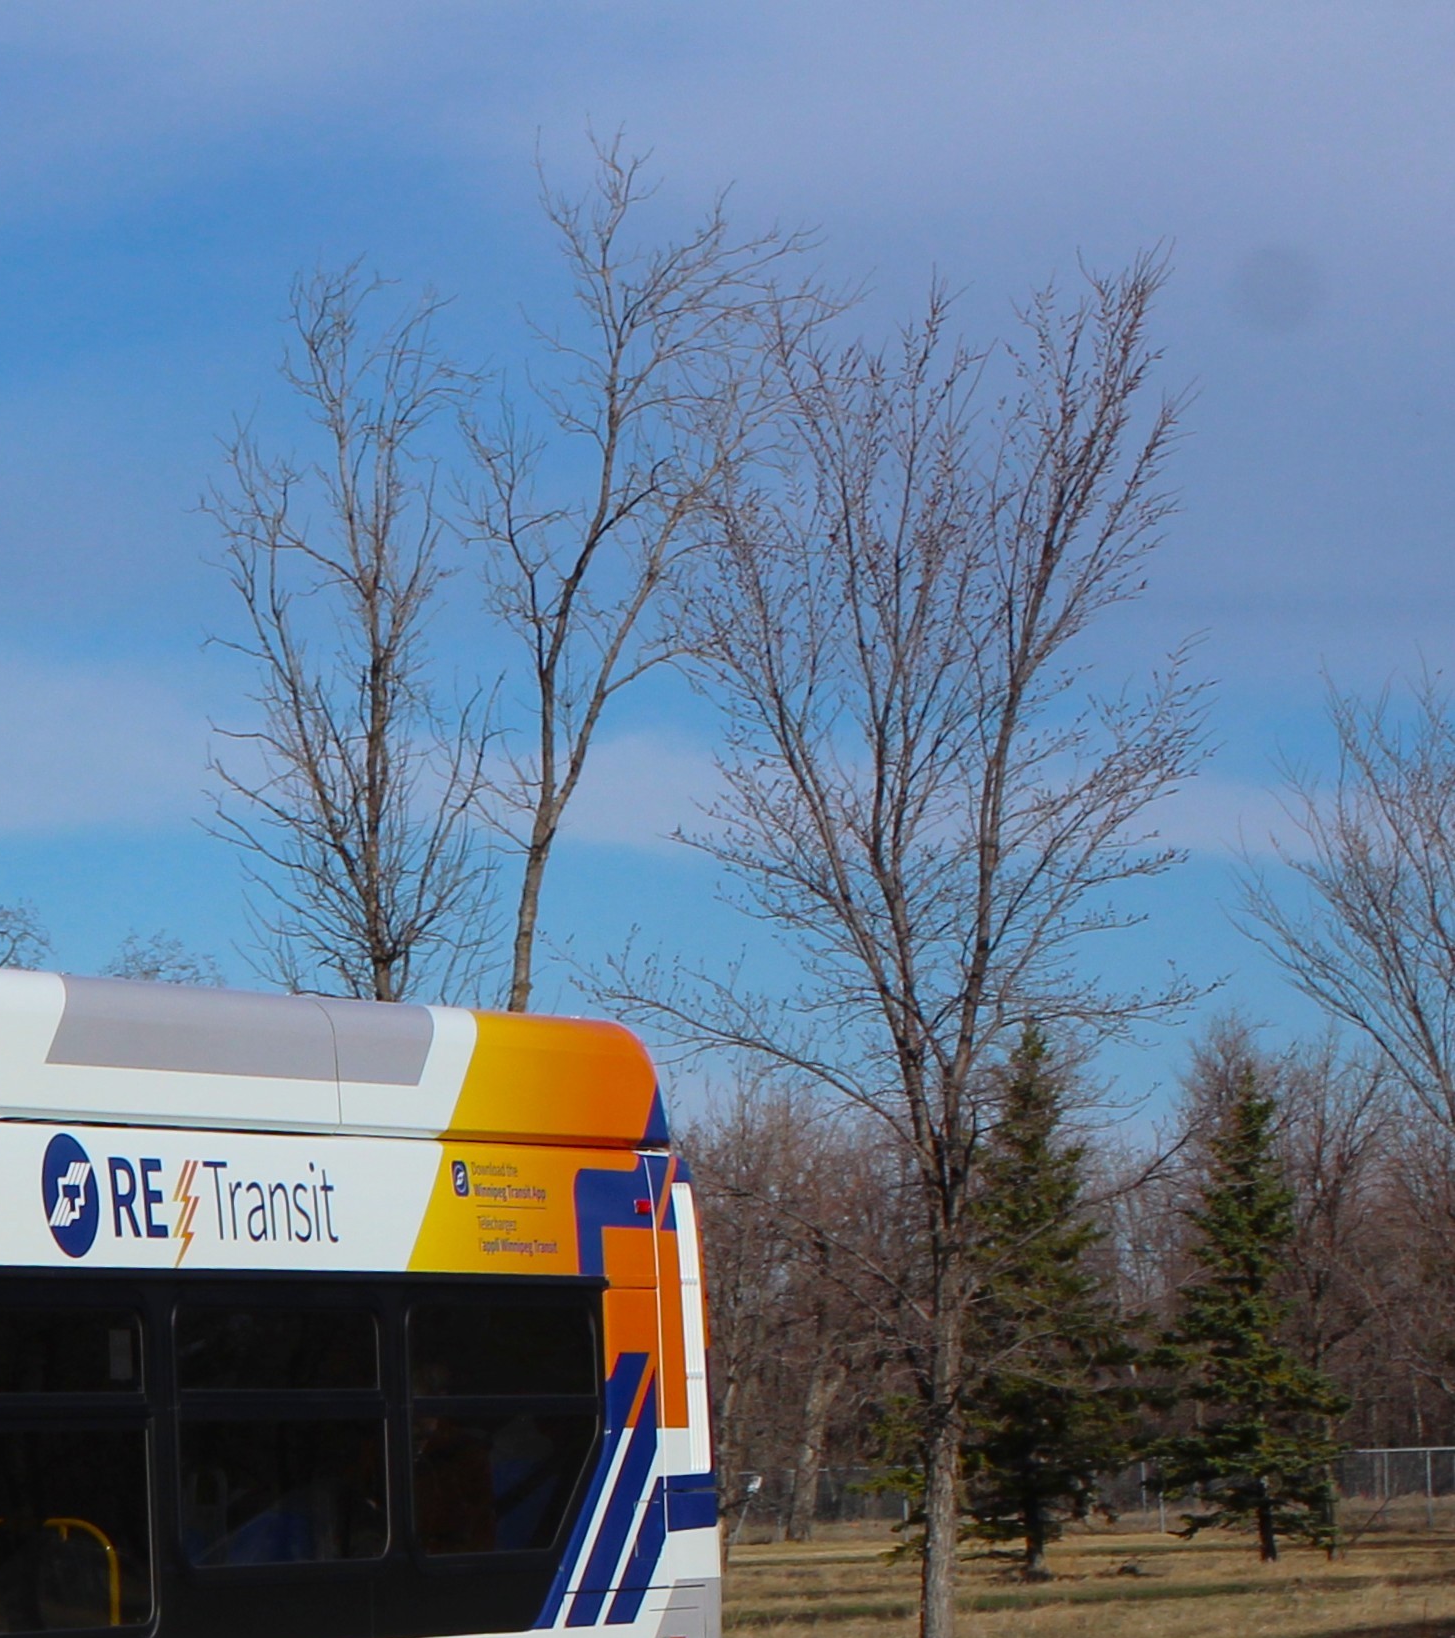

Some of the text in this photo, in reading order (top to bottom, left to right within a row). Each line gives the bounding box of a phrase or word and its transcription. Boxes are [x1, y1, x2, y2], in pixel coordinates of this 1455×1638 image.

[471, 1162, 518, 1177] Download the
[107, 1156, 340, 1243] RE Transit
[473, 1183, 546, 1203] Winnipeg Transit App
[501, 1238, 533, 1256] Winnipeg
[534, 1240, 558, 1254] Transit
